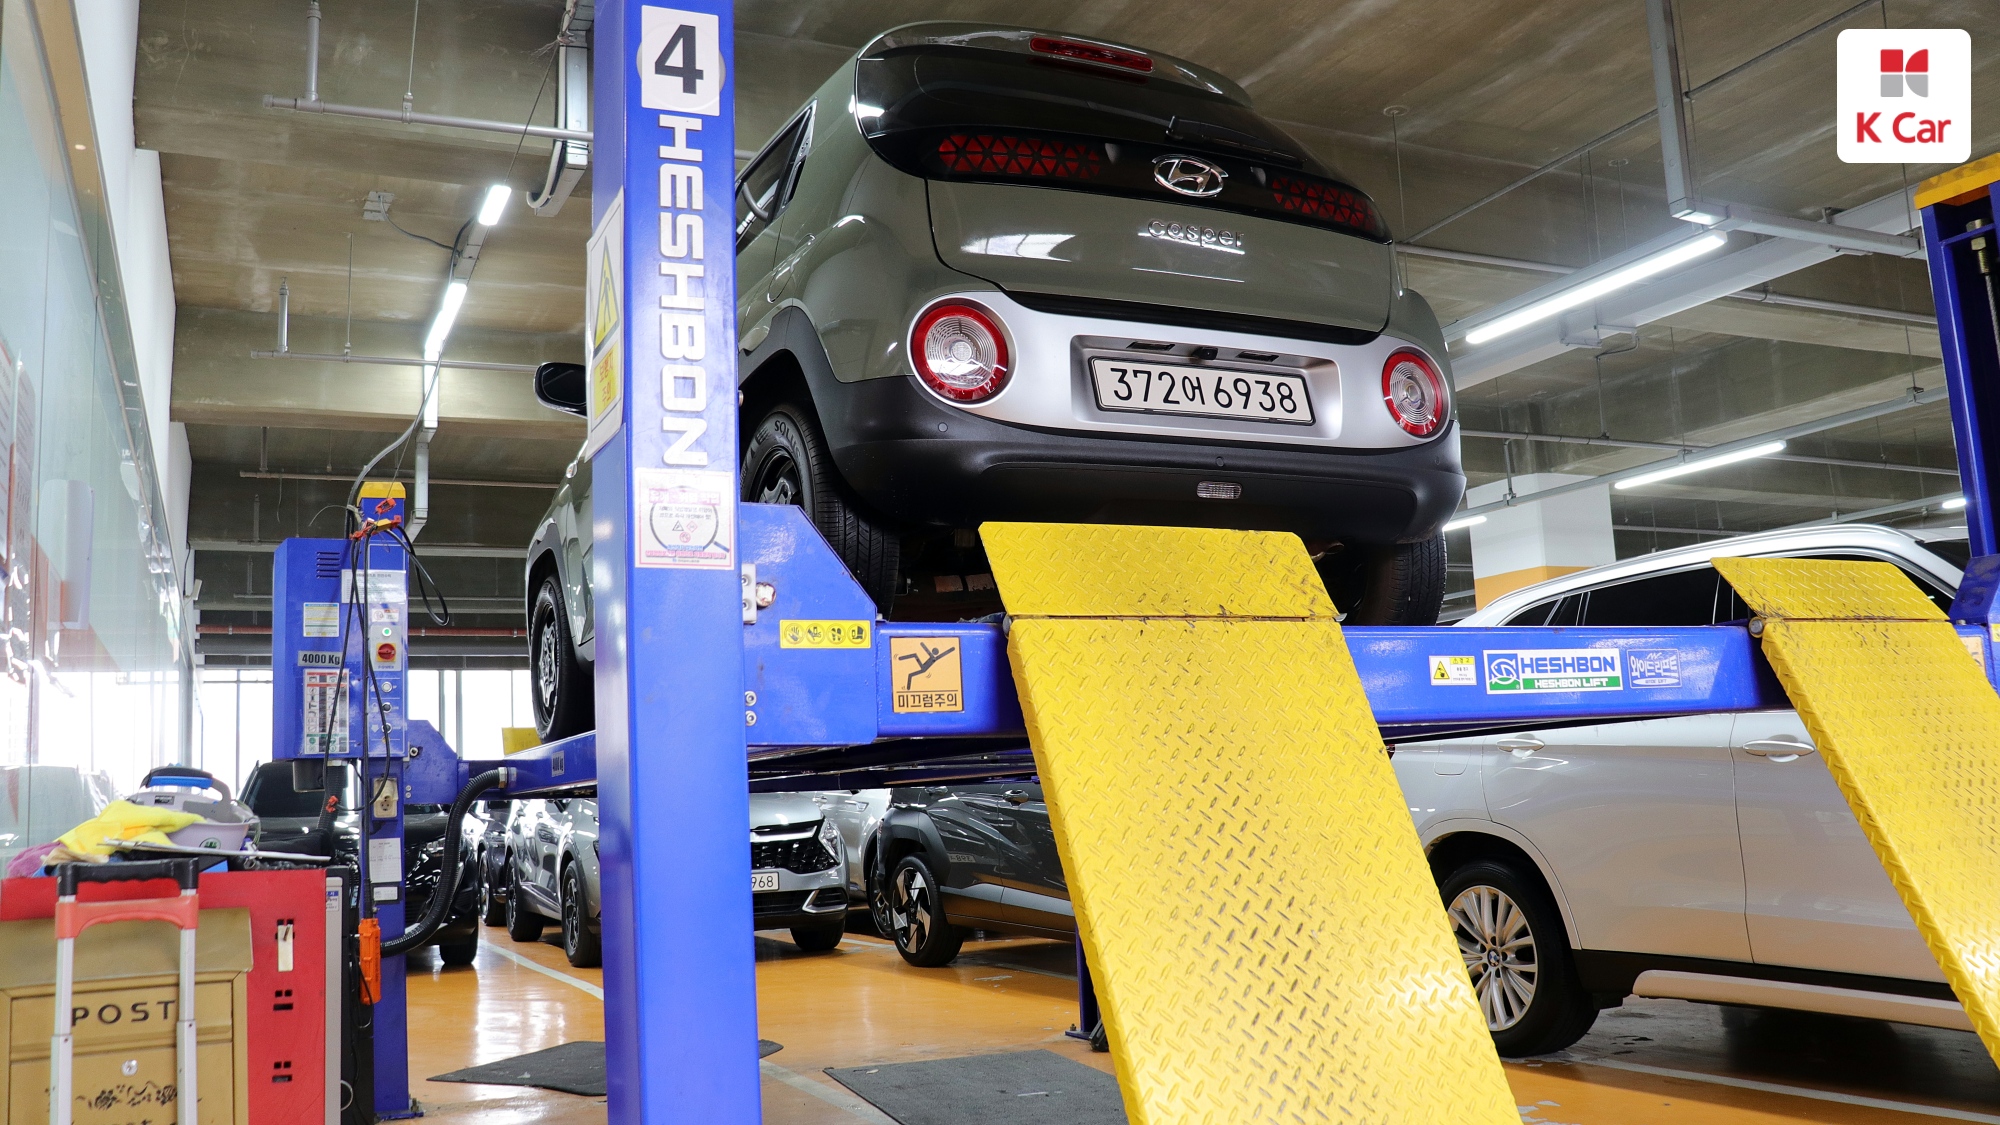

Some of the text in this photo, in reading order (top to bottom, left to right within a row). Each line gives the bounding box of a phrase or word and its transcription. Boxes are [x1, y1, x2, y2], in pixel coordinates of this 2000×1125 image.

[655, 24, 704, 94] 4
[1148, 219, 1245, 248] casper
[658, 114, 708, 468] HESHBON
[1110, 367, 1298, 414] 372어 6938
[302, 653, 341, 665] 4000 Kg
[1520, 656, 1616, 674] HESHBON
[1630, 655, 1679, 678] 와이드리프트
[1534, 678, 1608, 689] HESHBON LIFT
[898, 693, 958, 708] 미끄럼주의
[751, 875, 774, 888] 968
[72, 1000, 176, 1027] POST
